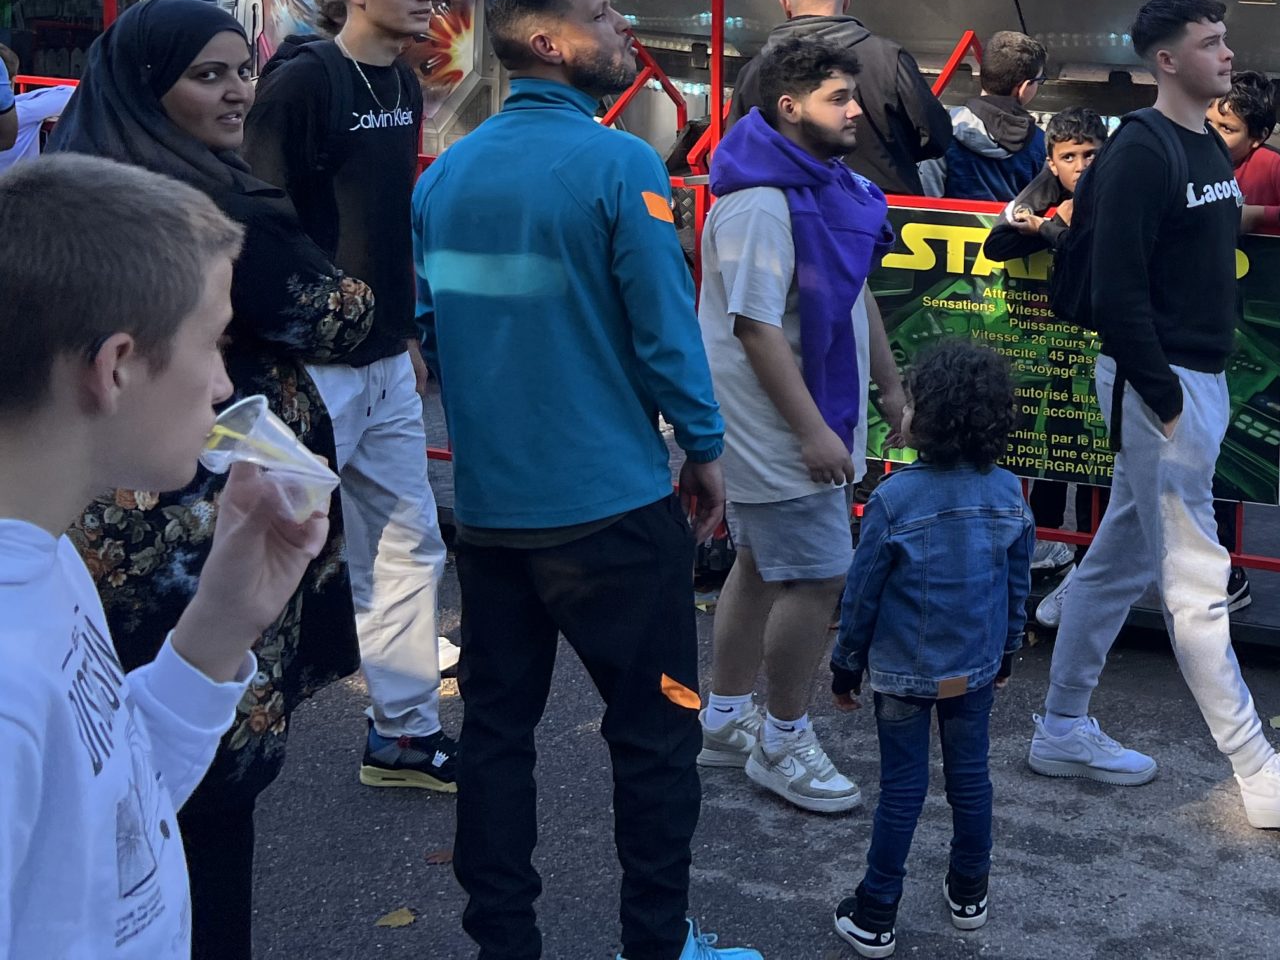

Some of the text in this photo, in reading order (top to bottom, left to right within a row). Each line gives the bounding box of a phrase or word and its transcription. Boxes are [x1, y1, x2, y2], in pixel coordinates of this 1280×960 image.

[982, 287, 1048, 302] Attraction
[922, 296, 996, 312] Sensations
[1009, 318, 1079, 334] Puissance
[971, 329, 1020, 343] Vitesse
[1031, 334, 1047, 345] 26
[1051, 336, 1086, 349] tours
[1049, 350, 1065, 362] 45
[1030, 365, 1077, 379] voyage
[1014, 387, 1097, 404] autorisé aux
[1022, 404, 1039, 415] ou
[1051, 434, 1074, 445] par
[1077, 434, 1089, 446] le
[1017, 444, 1049, 456] pour
[1052, 449, 1078, 459] une
